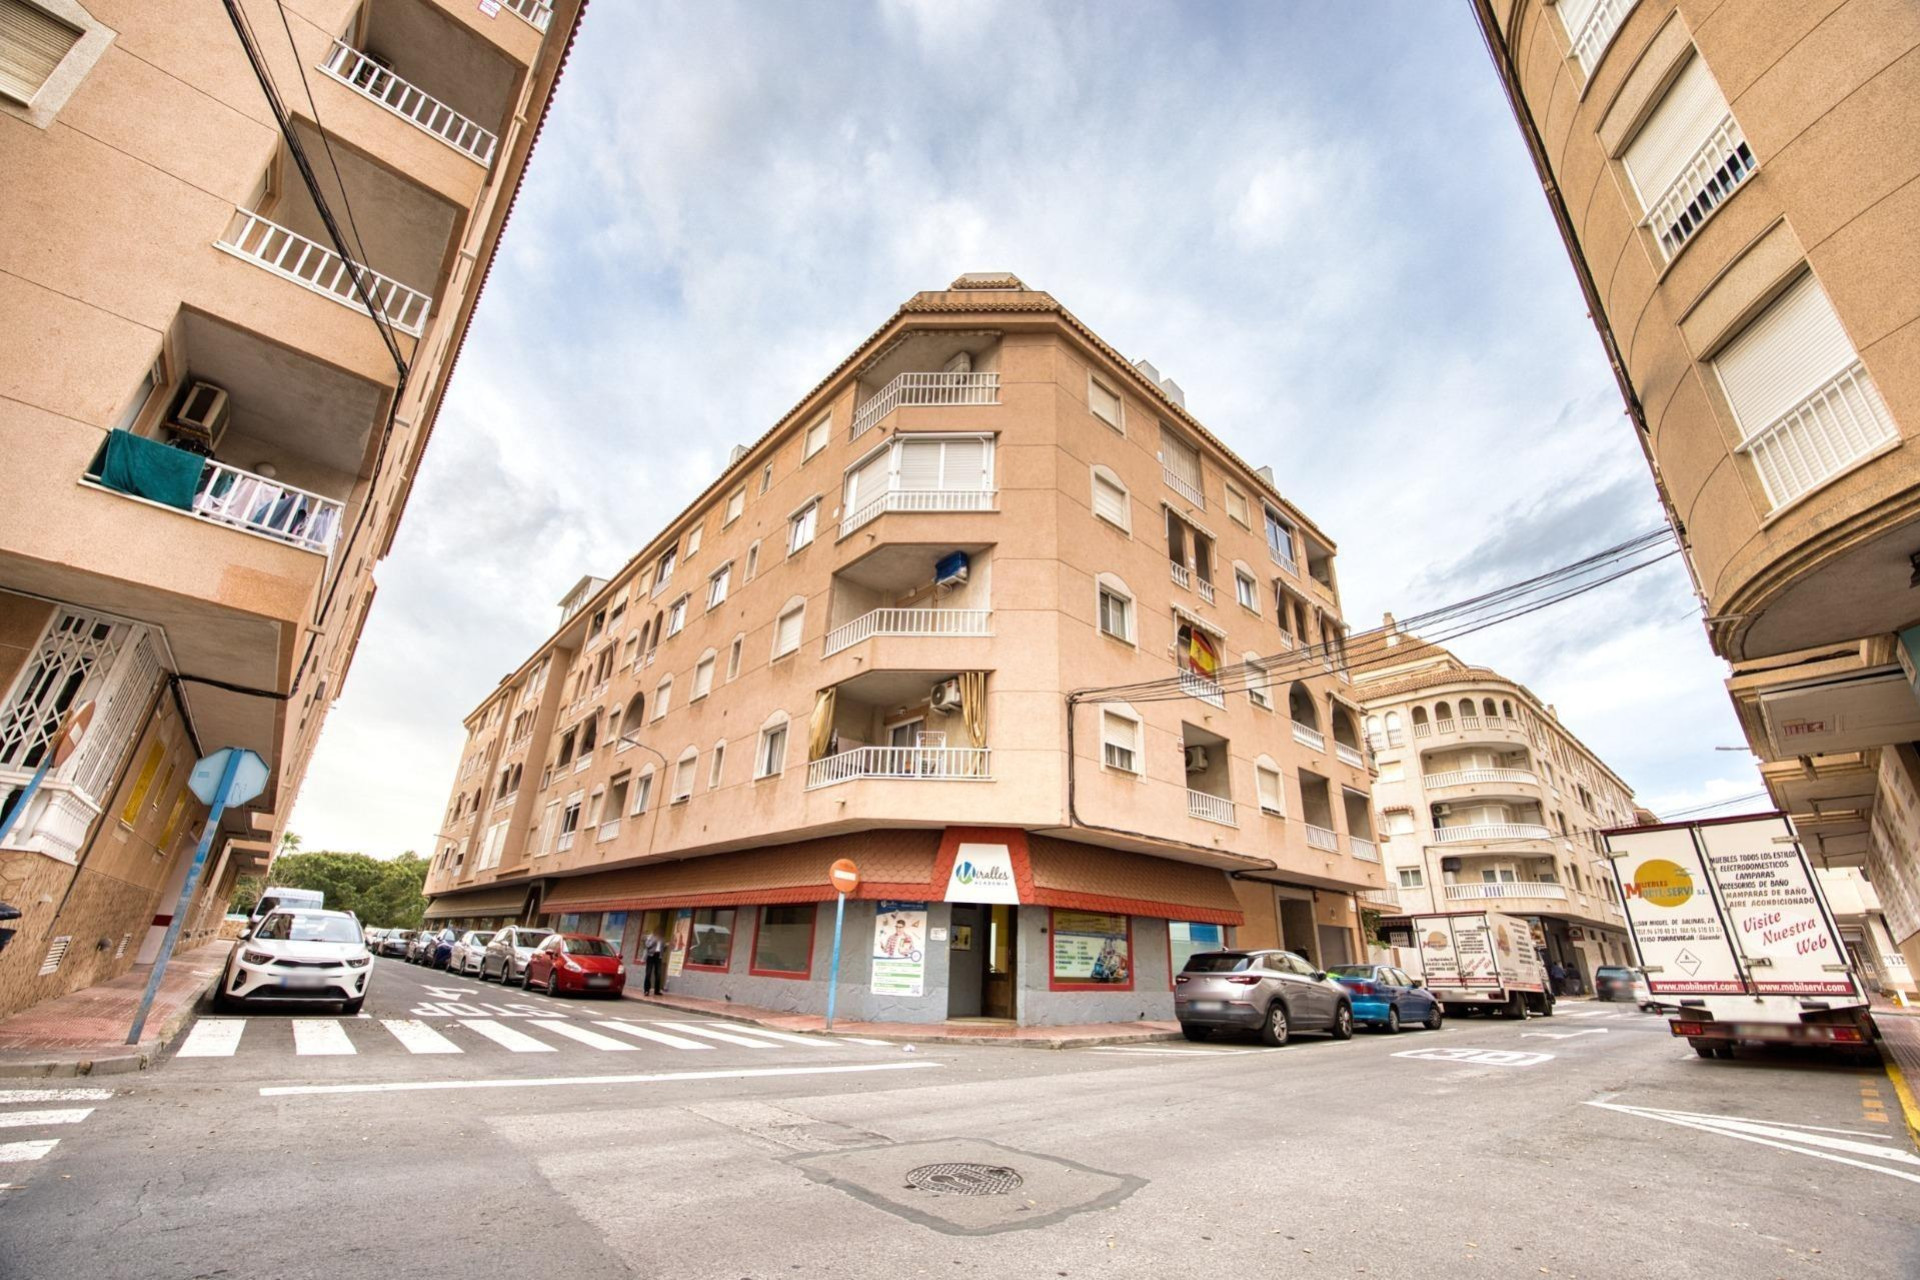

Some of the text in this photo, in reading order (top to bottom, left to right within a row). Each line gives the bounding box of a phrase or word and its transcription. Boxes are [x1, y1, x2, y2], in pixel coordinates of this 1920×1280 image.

[1709, 850, 1797, 864] MUEBLES TODOS LOS ESTILOS
[1720, 861, 1789, 872] ELECTRODOMESTICOS
[956, 861, 1009, 885] Miralles
[1736, 871, 1775, 880] LAMPARAS
[1720, 881, 1756, 890] ACCESORIOS
[1770, 879, 1789, 887] BAÑO
[1667, 886, 1694, 897] SERVI
[1726, 889, 1768, 899] MAMPARAS
[1785, 887, 1807, 896] BAÑO
[1729, 897, 1815, 908] AIRE ACONDICIONADO
[1743, 912, 1781, 934] Visite
[1763, 918, 1816, 946] Nuestra
[1796, 934, 1827, 955] Web
[1656, 982, 1738, 991] www.mobilservi.com
[1758, 982, 1846, 992] www.mobilservi.com
[410, 1002, 570, 1018] STOP
